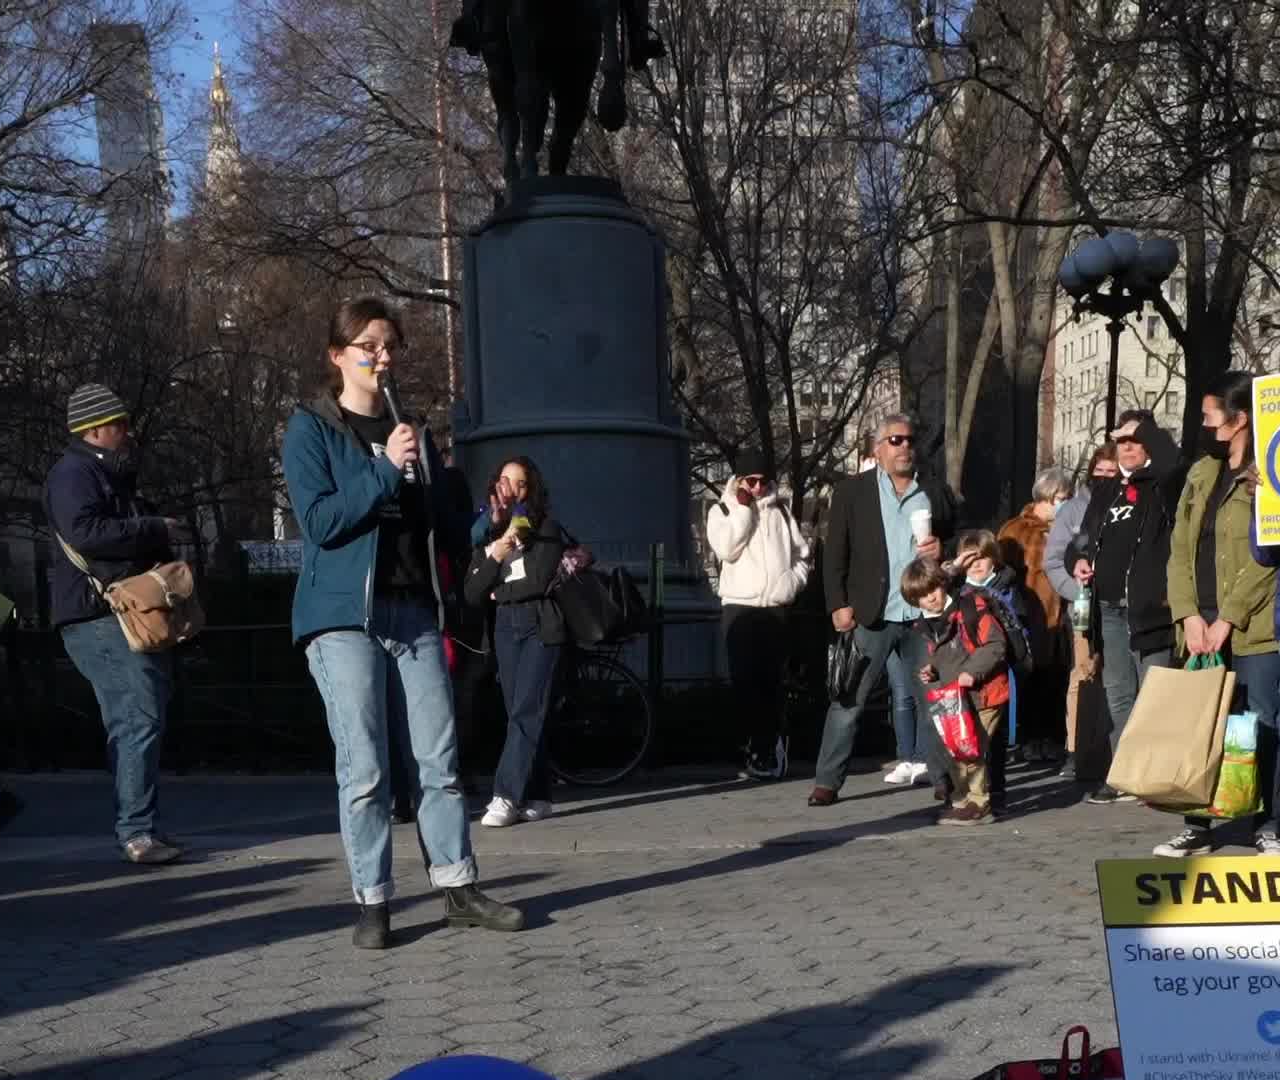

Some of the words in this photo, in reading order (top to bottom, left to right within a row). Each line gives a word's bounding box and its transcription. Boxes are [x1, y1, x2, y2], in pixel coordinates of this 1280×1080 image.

[1123, 943, 1185, 962] Share
[1191, 945, 1219, 961] on
[1152, 975, 1189, 996] tag
[1191, 975, 1240, 996] your
